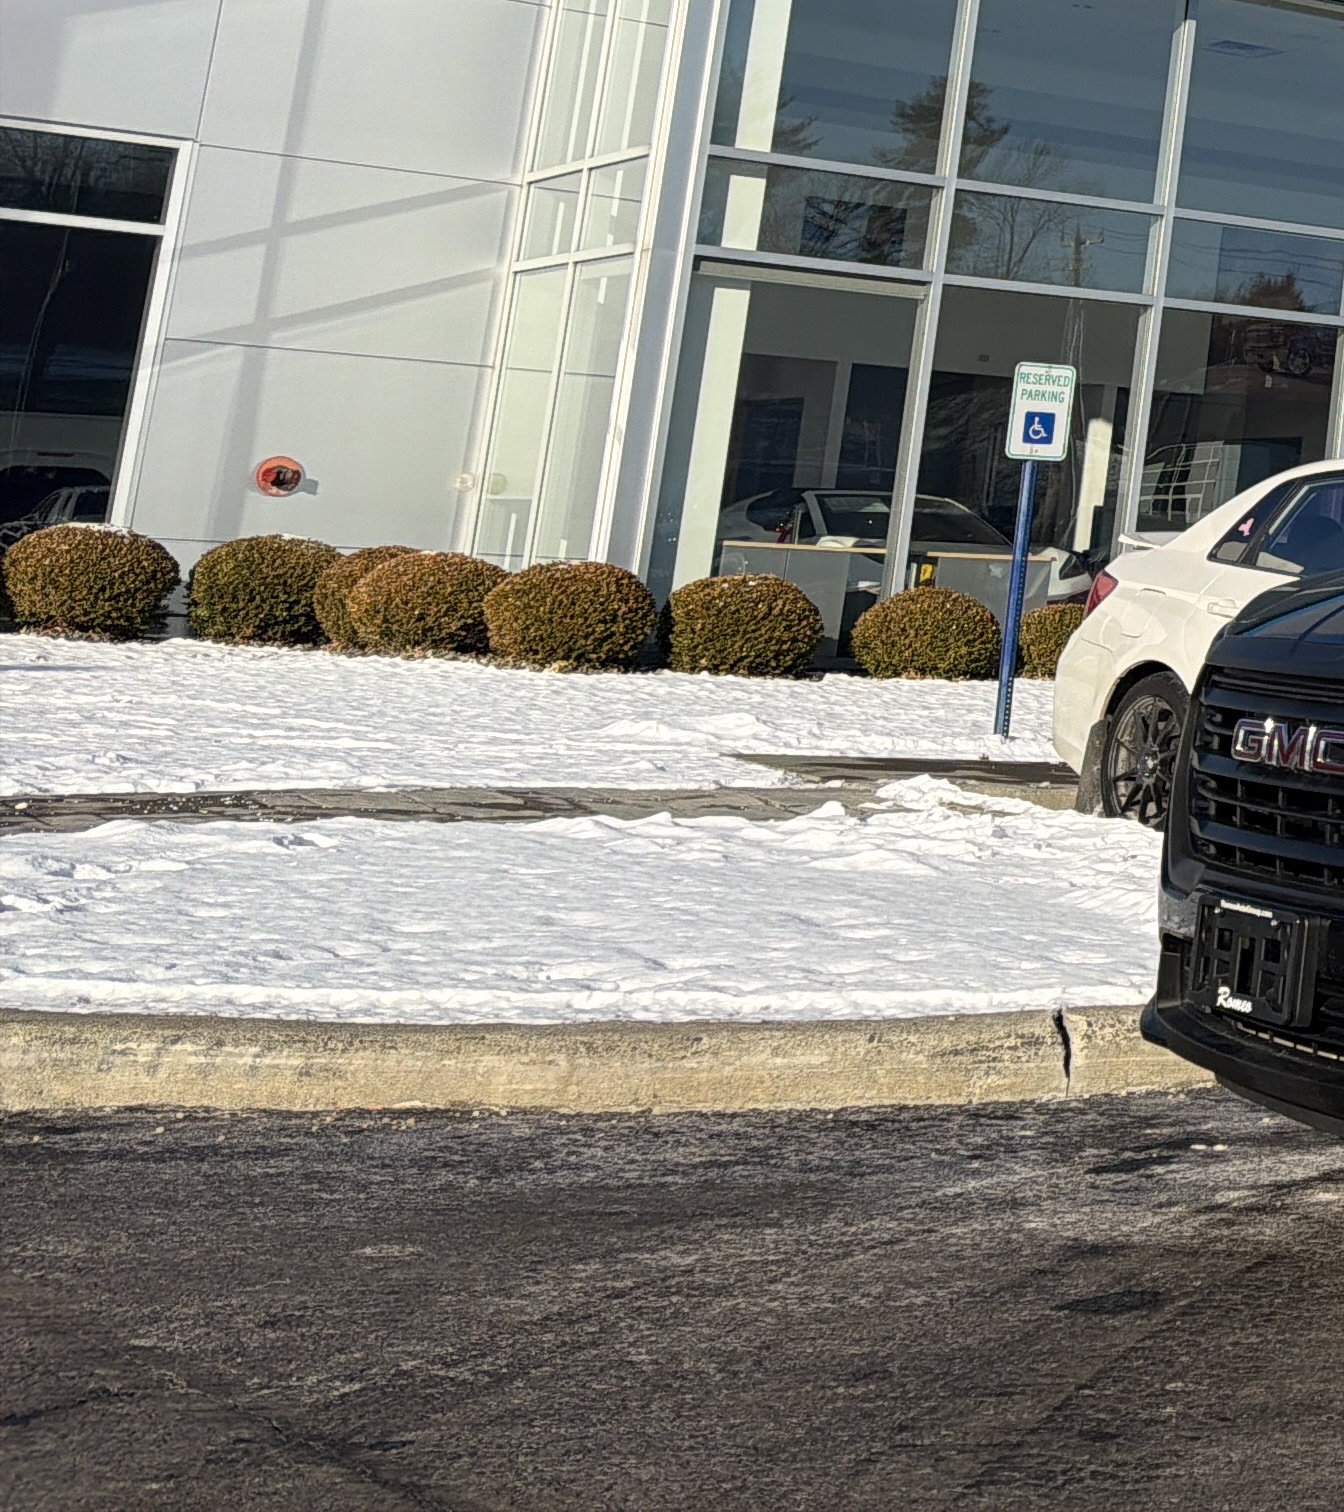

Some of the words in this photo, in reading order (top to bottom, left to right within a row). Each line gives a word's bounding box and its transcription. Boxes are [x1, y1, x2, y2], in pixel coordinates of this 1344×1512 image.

[1019, 372, 1071, 387] RESERVED
[1020, 388, 1065, 403] PARKING
[1216, 986, 1253, 1014] Romeo
